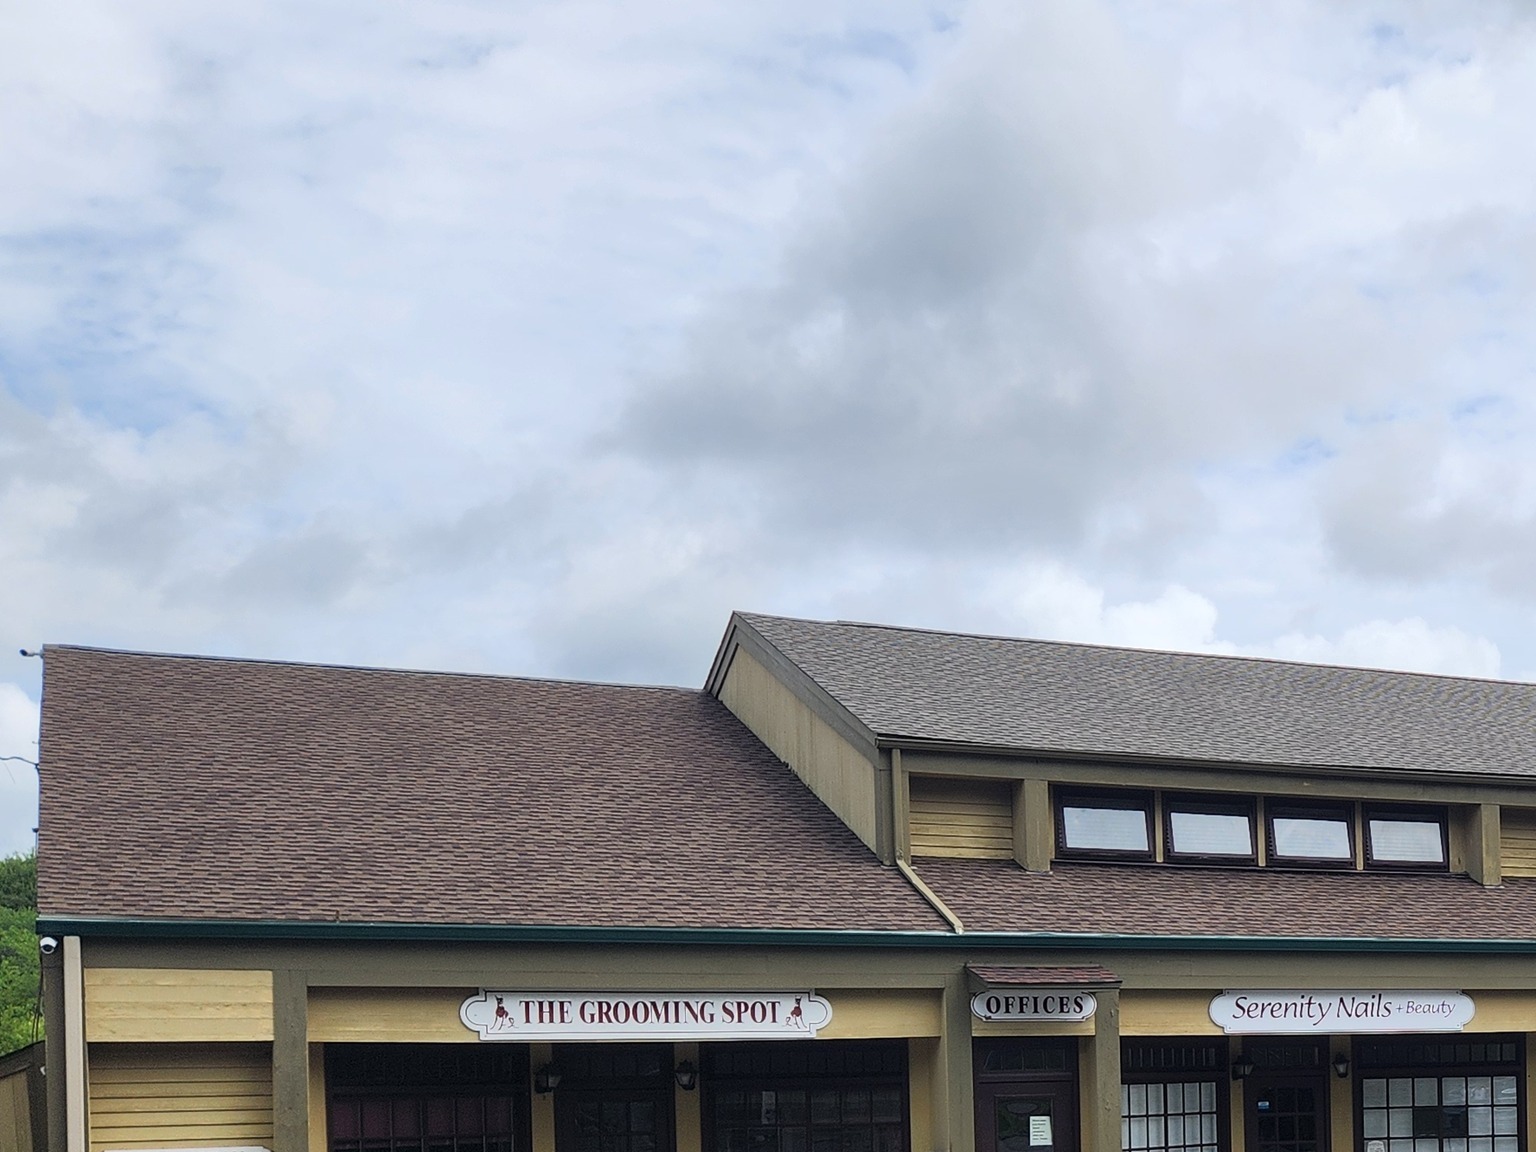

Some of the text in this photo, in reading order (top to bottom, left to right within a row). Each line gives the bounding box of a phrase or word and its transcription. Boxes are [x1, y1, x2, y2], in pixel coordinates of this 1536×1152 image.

[519, 1000, 781, 1024] THE GROOMING SPOT
[985, 995, 1084, 1014] OFFICES
[1232, 995, 1332, 1026] Serenity
[1336, 993, 1392, 1018] Nails
